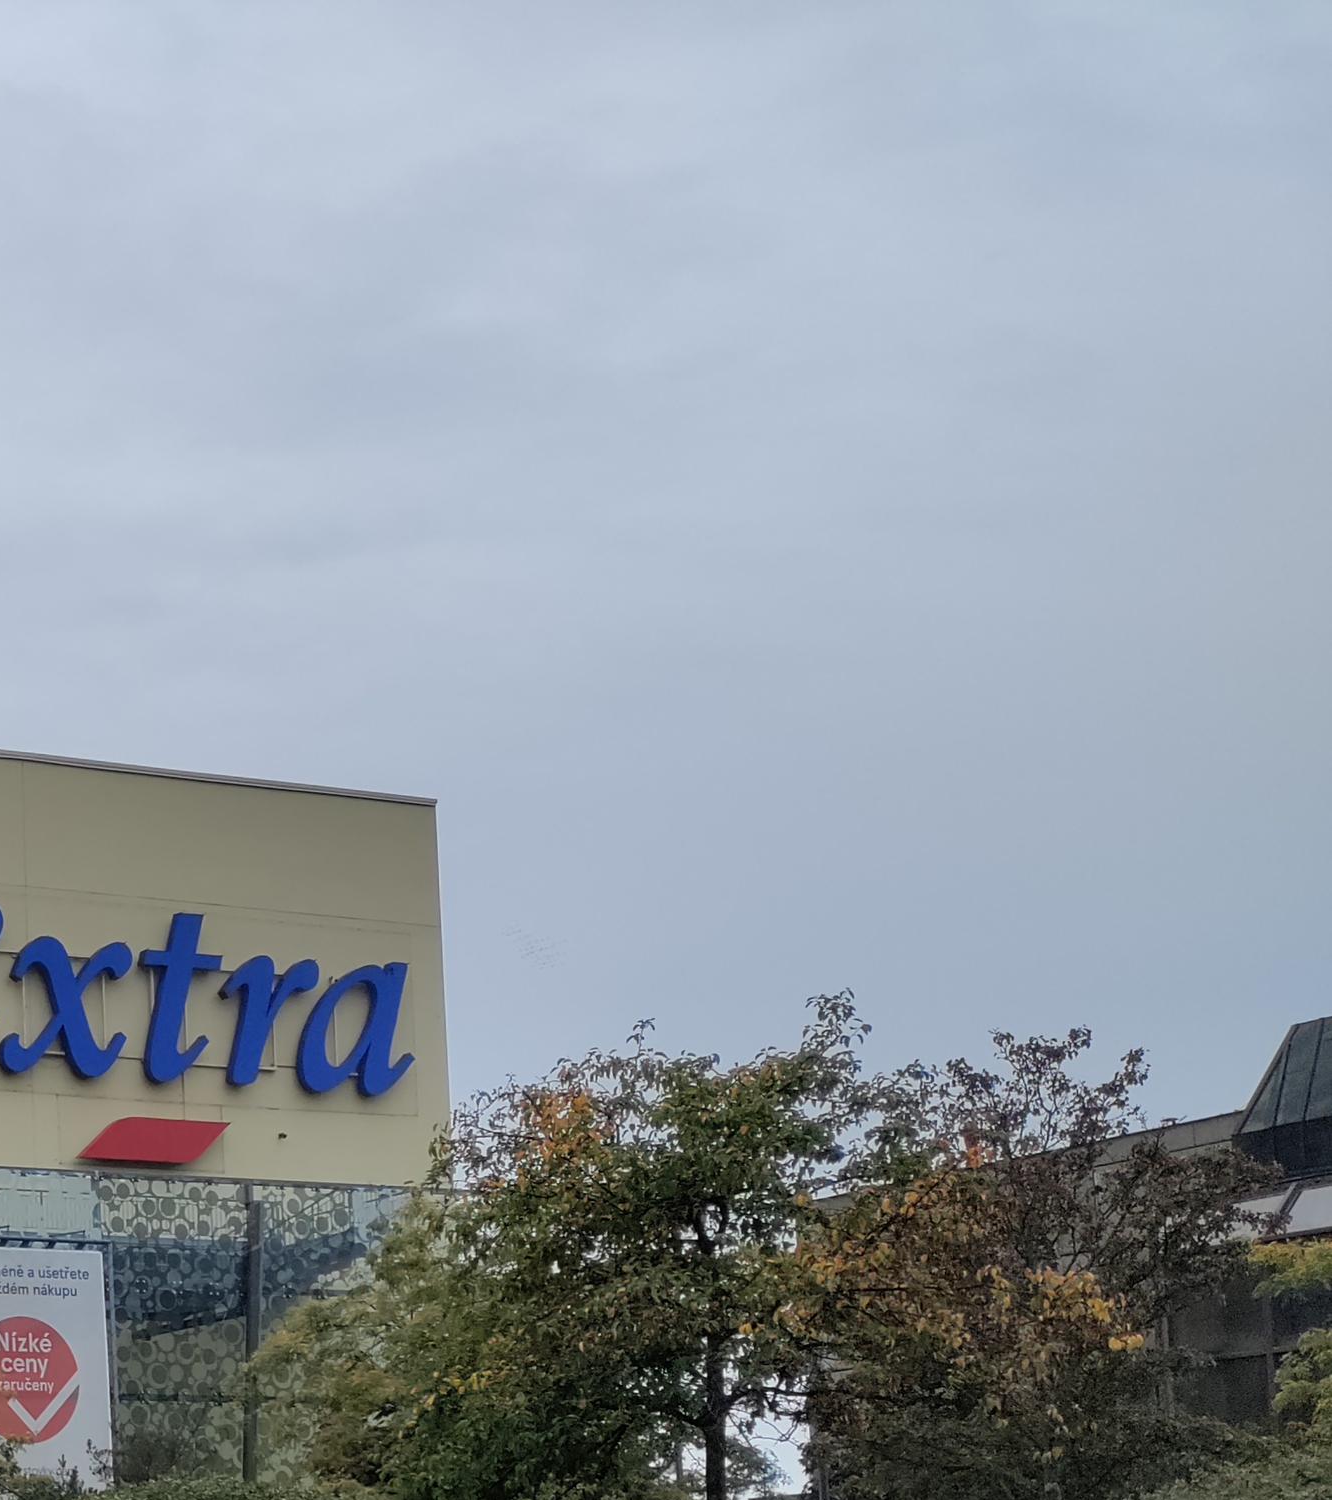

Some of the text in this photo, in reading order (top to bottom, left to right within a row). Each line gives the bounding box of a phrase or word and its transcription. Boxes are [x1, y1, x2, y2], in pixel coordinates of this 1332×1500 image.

[27, 1268, 35, 1278] a
[38, 1265, 89, 1280] ušetřete
[33, 1283, 77, 1299] nákupu
[1, 1357, 49, 1378] ceny
